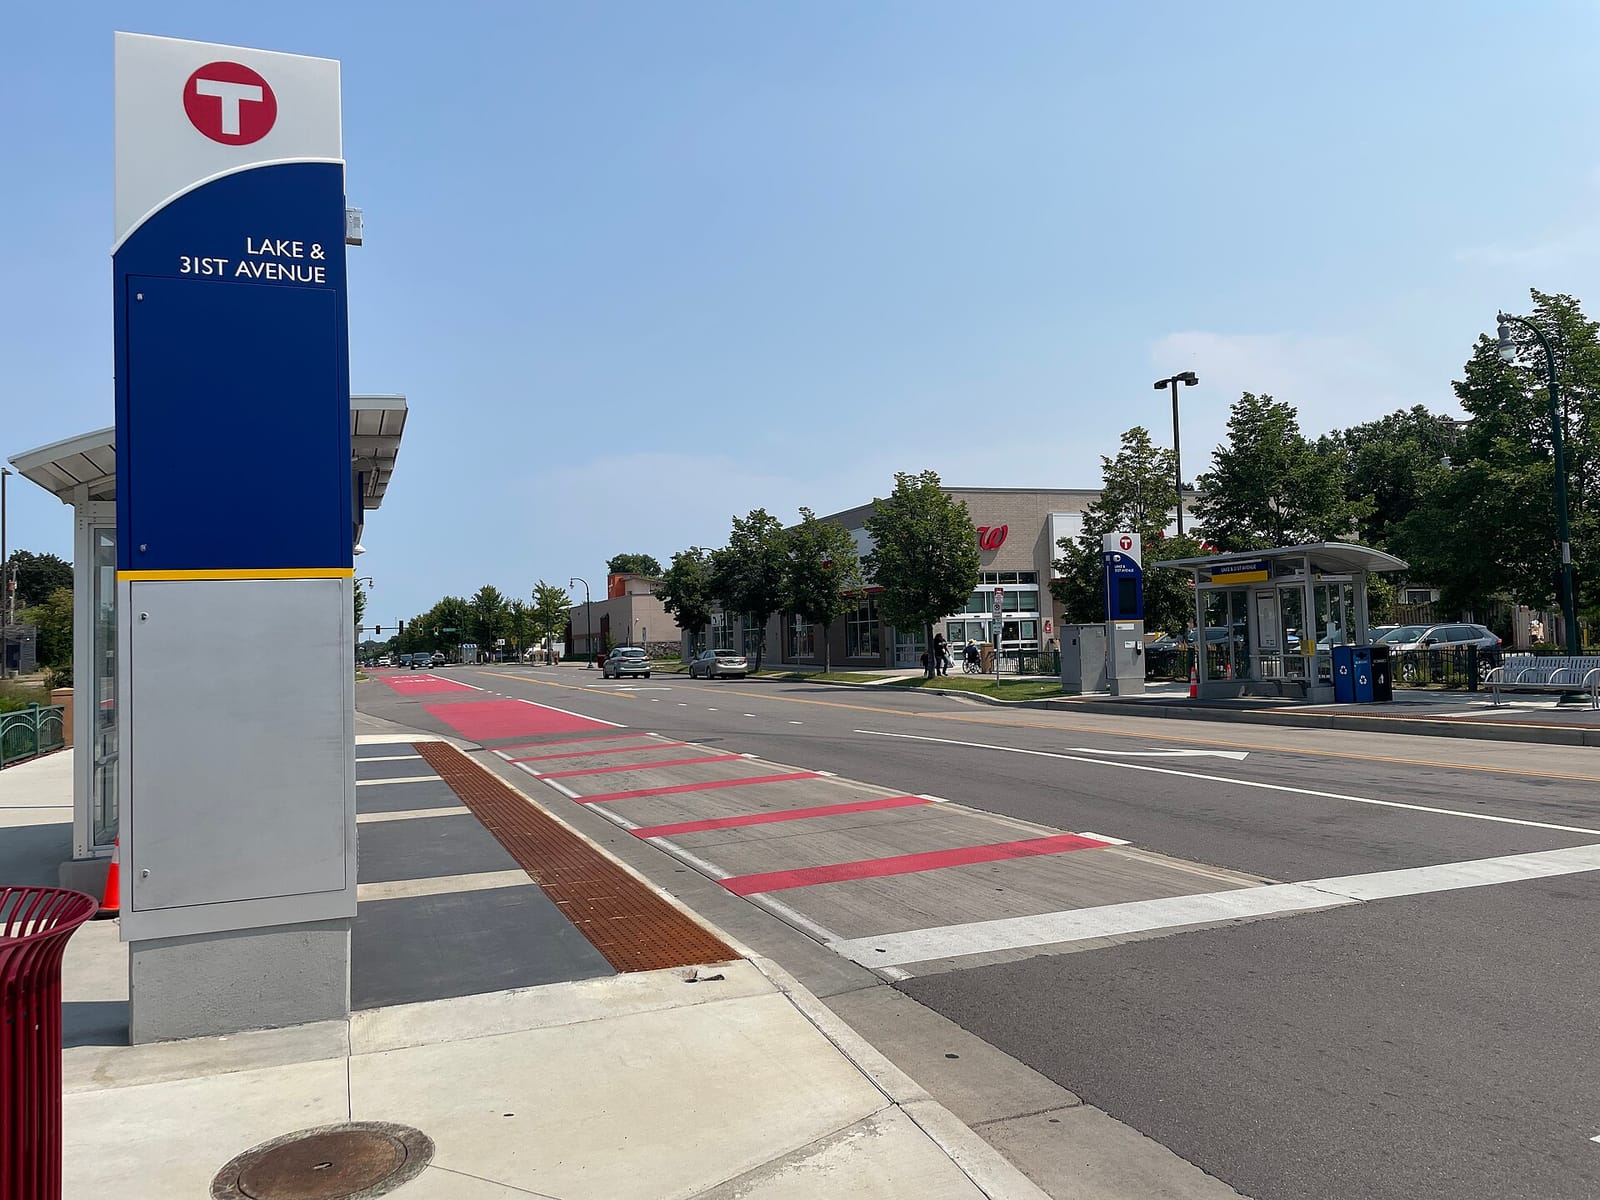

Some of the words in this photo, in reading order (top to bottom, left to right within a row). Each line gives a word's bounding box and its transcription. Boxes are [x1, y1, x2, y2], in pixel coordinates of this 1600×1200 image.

[196, 78, 263, 136] T
[246, 237, 304, 259] LAKE
[310, 243, 326, 260] &
[180, 256, 229, 276] 31ST
[234, 260, 326, 284] AVENUE
